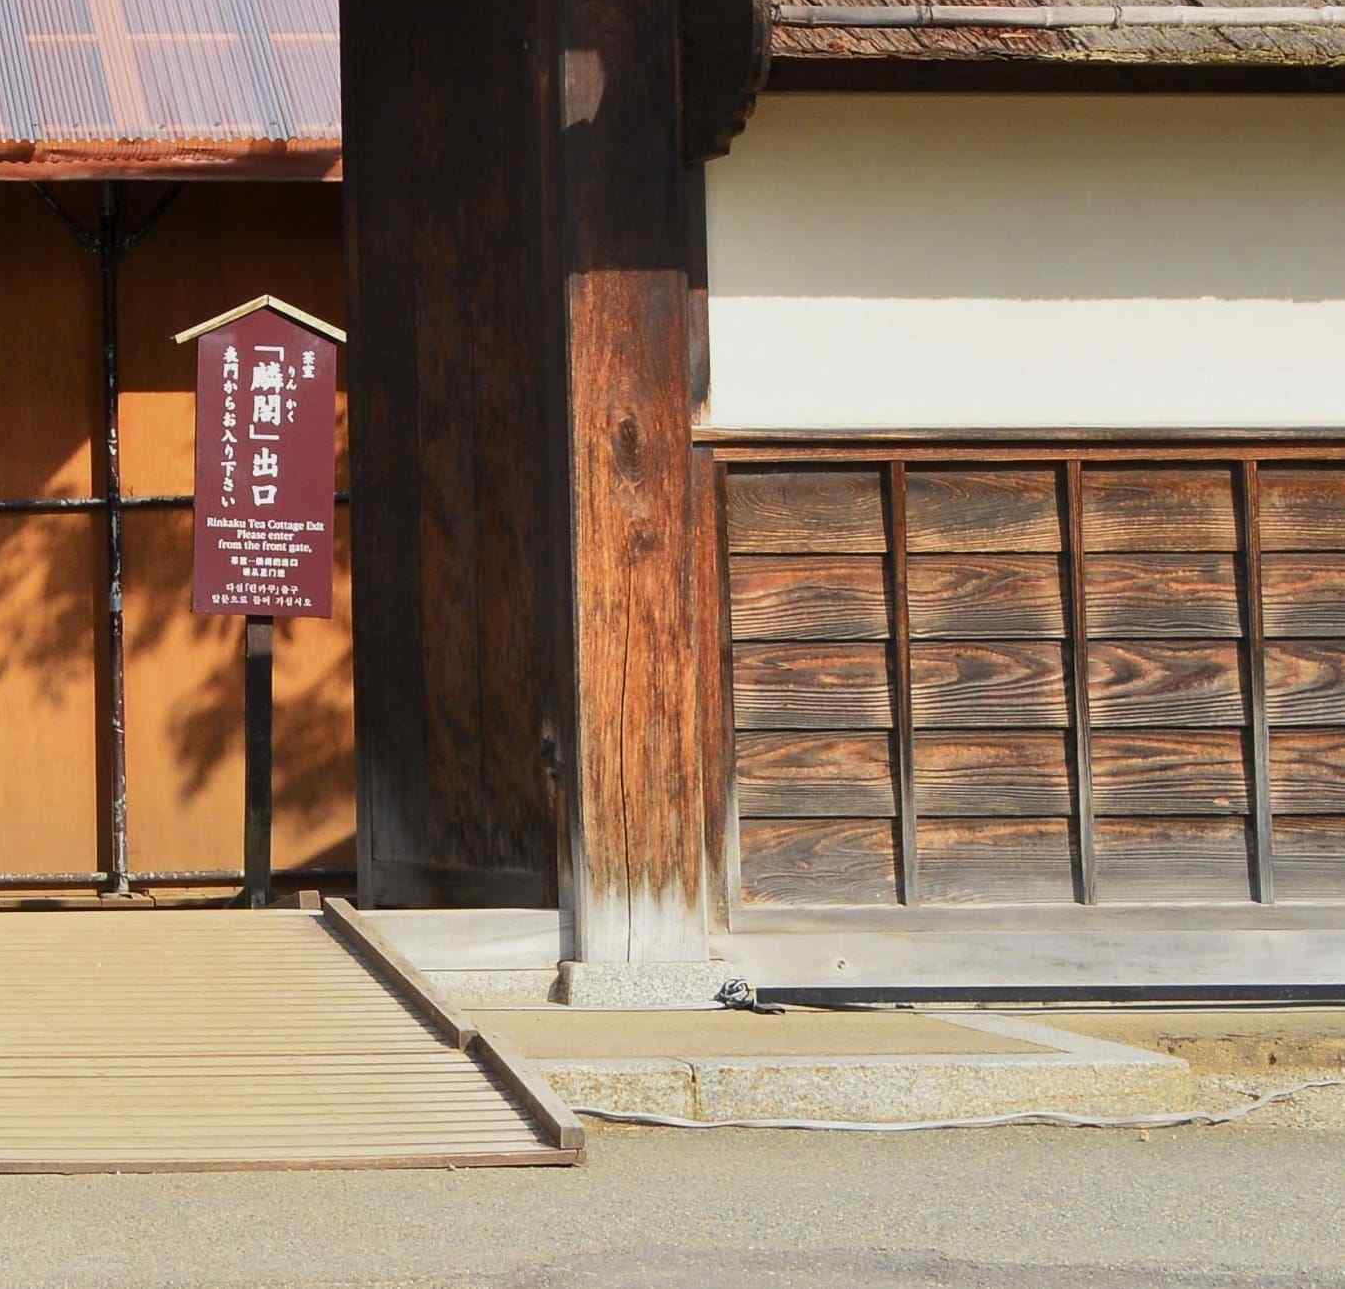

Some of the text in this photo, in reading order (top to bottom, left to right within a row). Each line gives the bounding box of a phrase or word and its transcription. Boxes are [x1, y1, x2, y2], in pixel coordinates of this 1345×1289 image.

[206, 517, 325, 532] Rinkaku Tea Cottage Exit
[236, 529, 295, 541] Please enter
[218, 539, 242, 549] from
[244, 540, 261, 551] the
[262, 541, 287, 552] front
